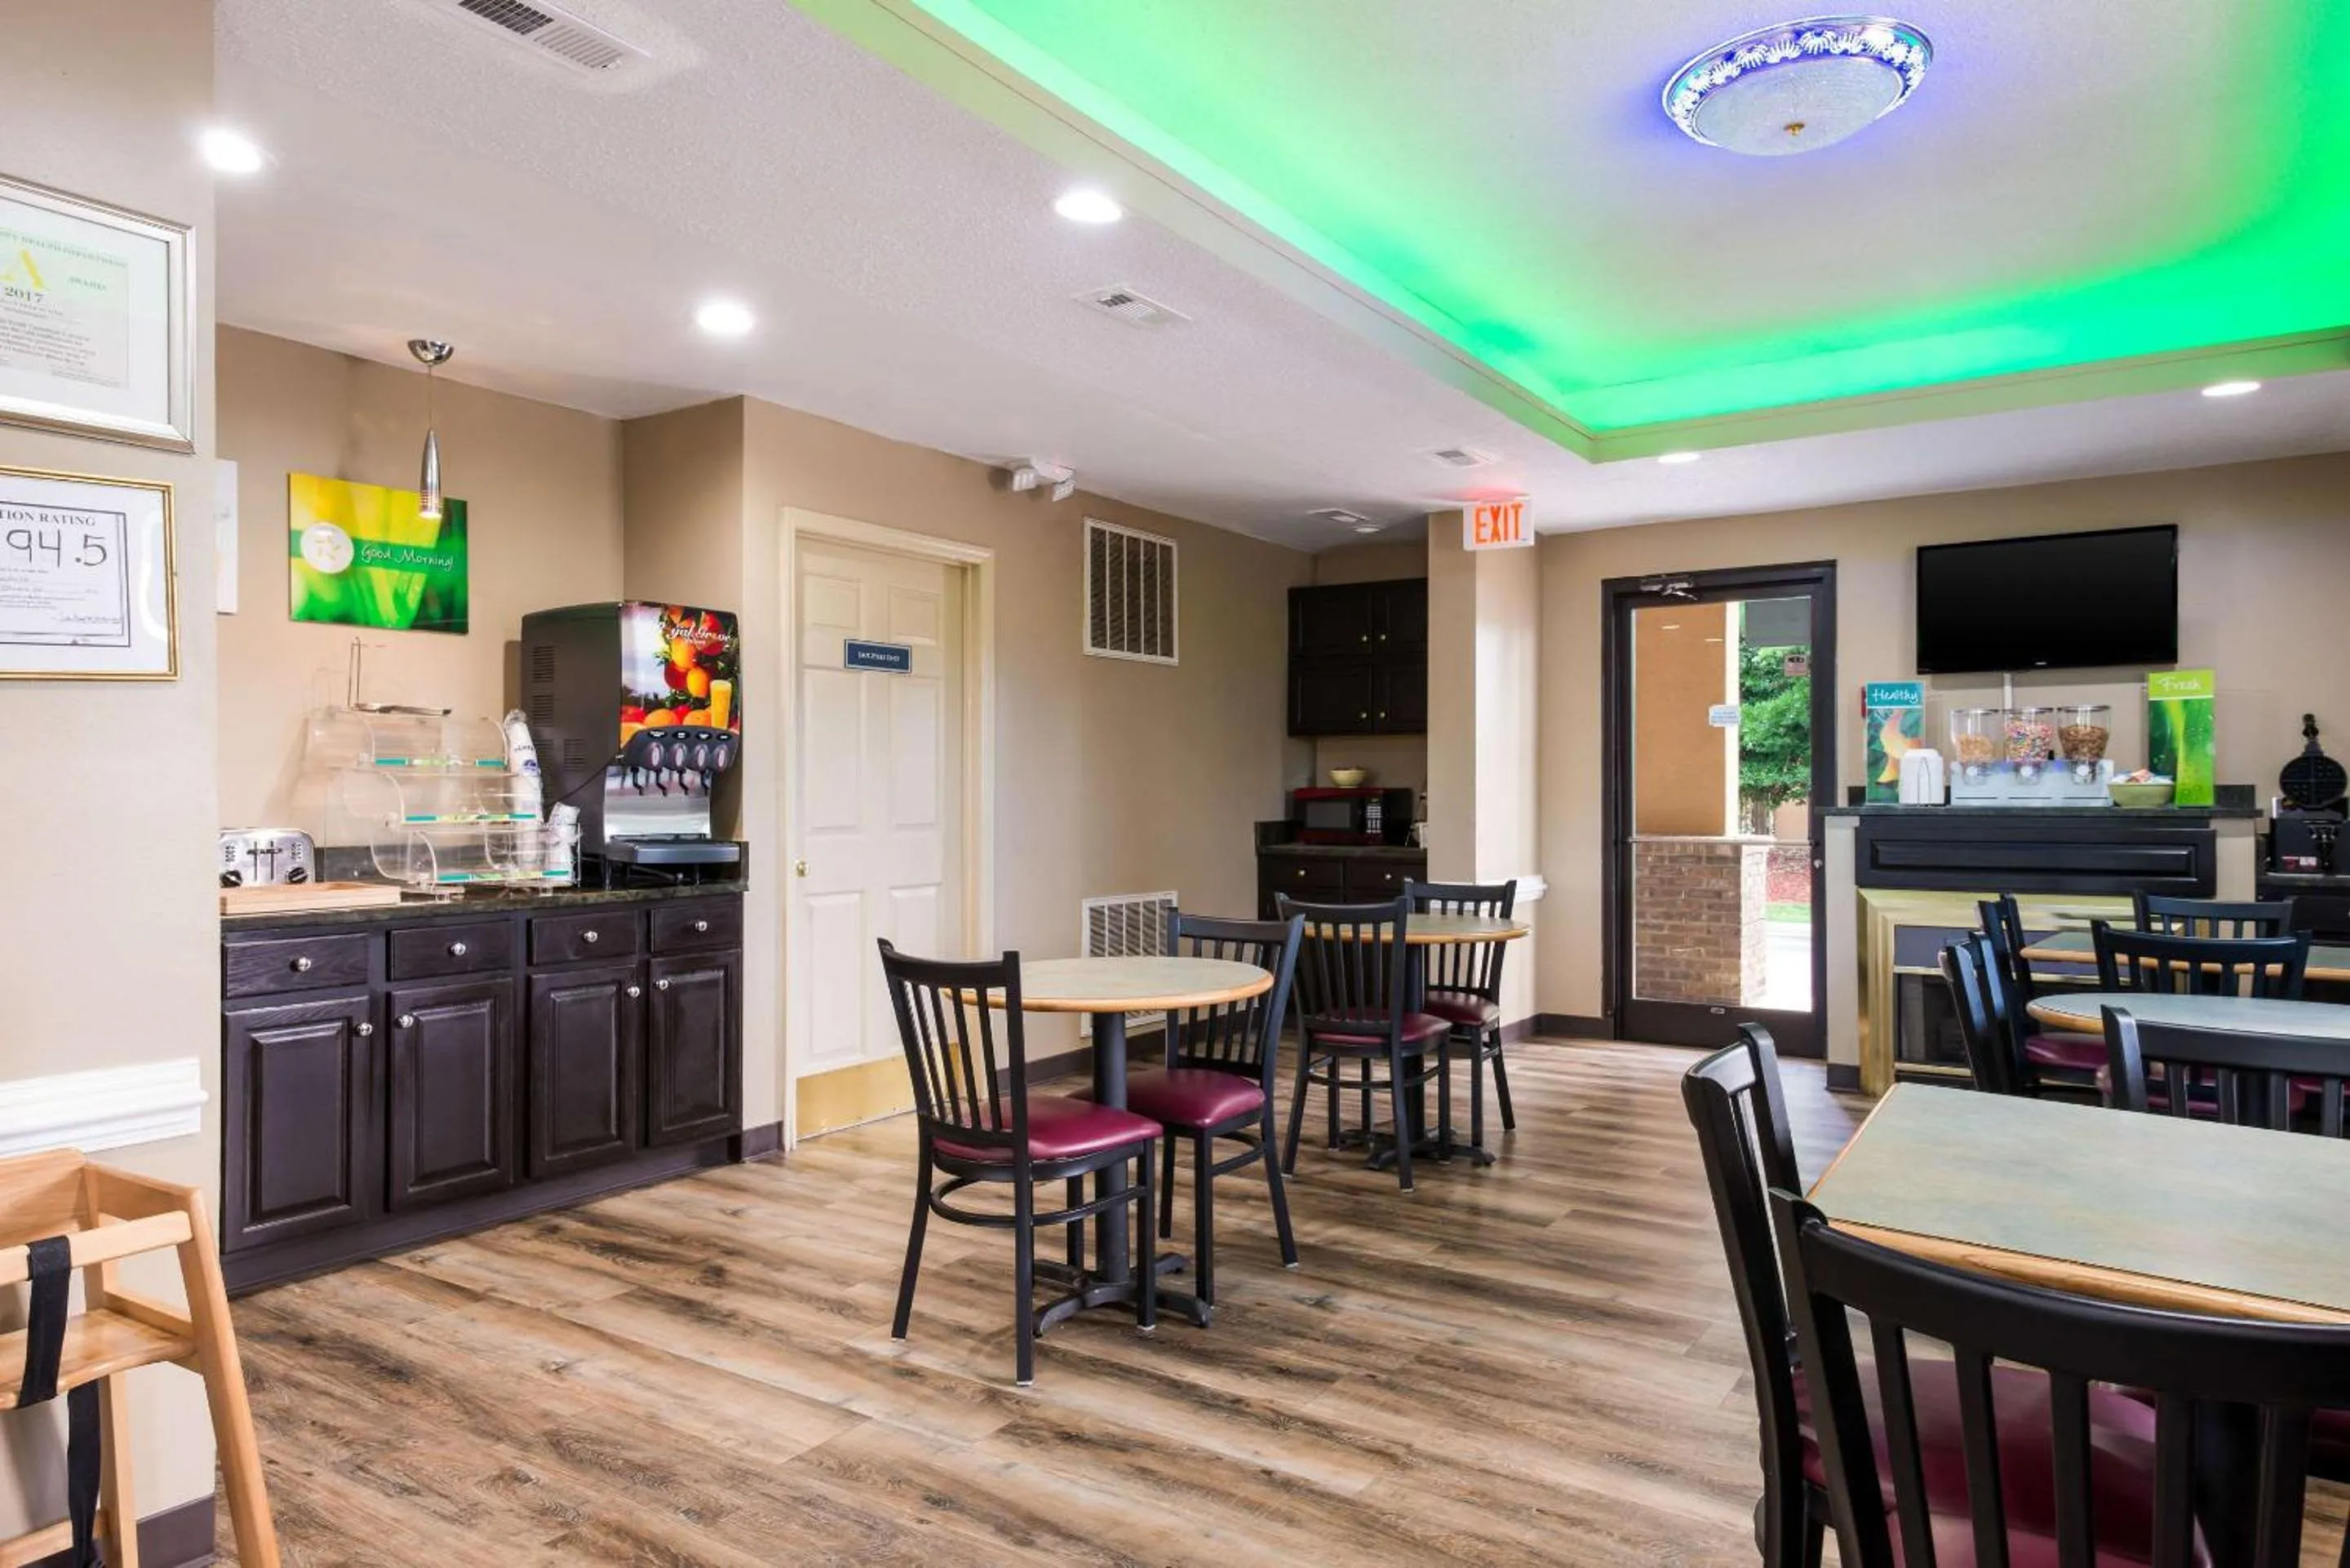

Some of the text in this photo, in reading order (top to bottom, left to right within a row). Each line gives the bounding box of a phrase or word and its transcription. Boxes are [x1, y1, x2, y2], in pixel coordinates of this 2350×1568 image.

[4, 286, 44, 303] 2017
[40, 513, 96, 526] RATING
[1474, 503, 1523, 544] EXIT
[7, 529, 107, 568] 94.5
[361, 543, 454, 572] Good Morning!
[2157, 676, 2201, 693] Fresh
[1873, 689, 1918, 704] Healthy
